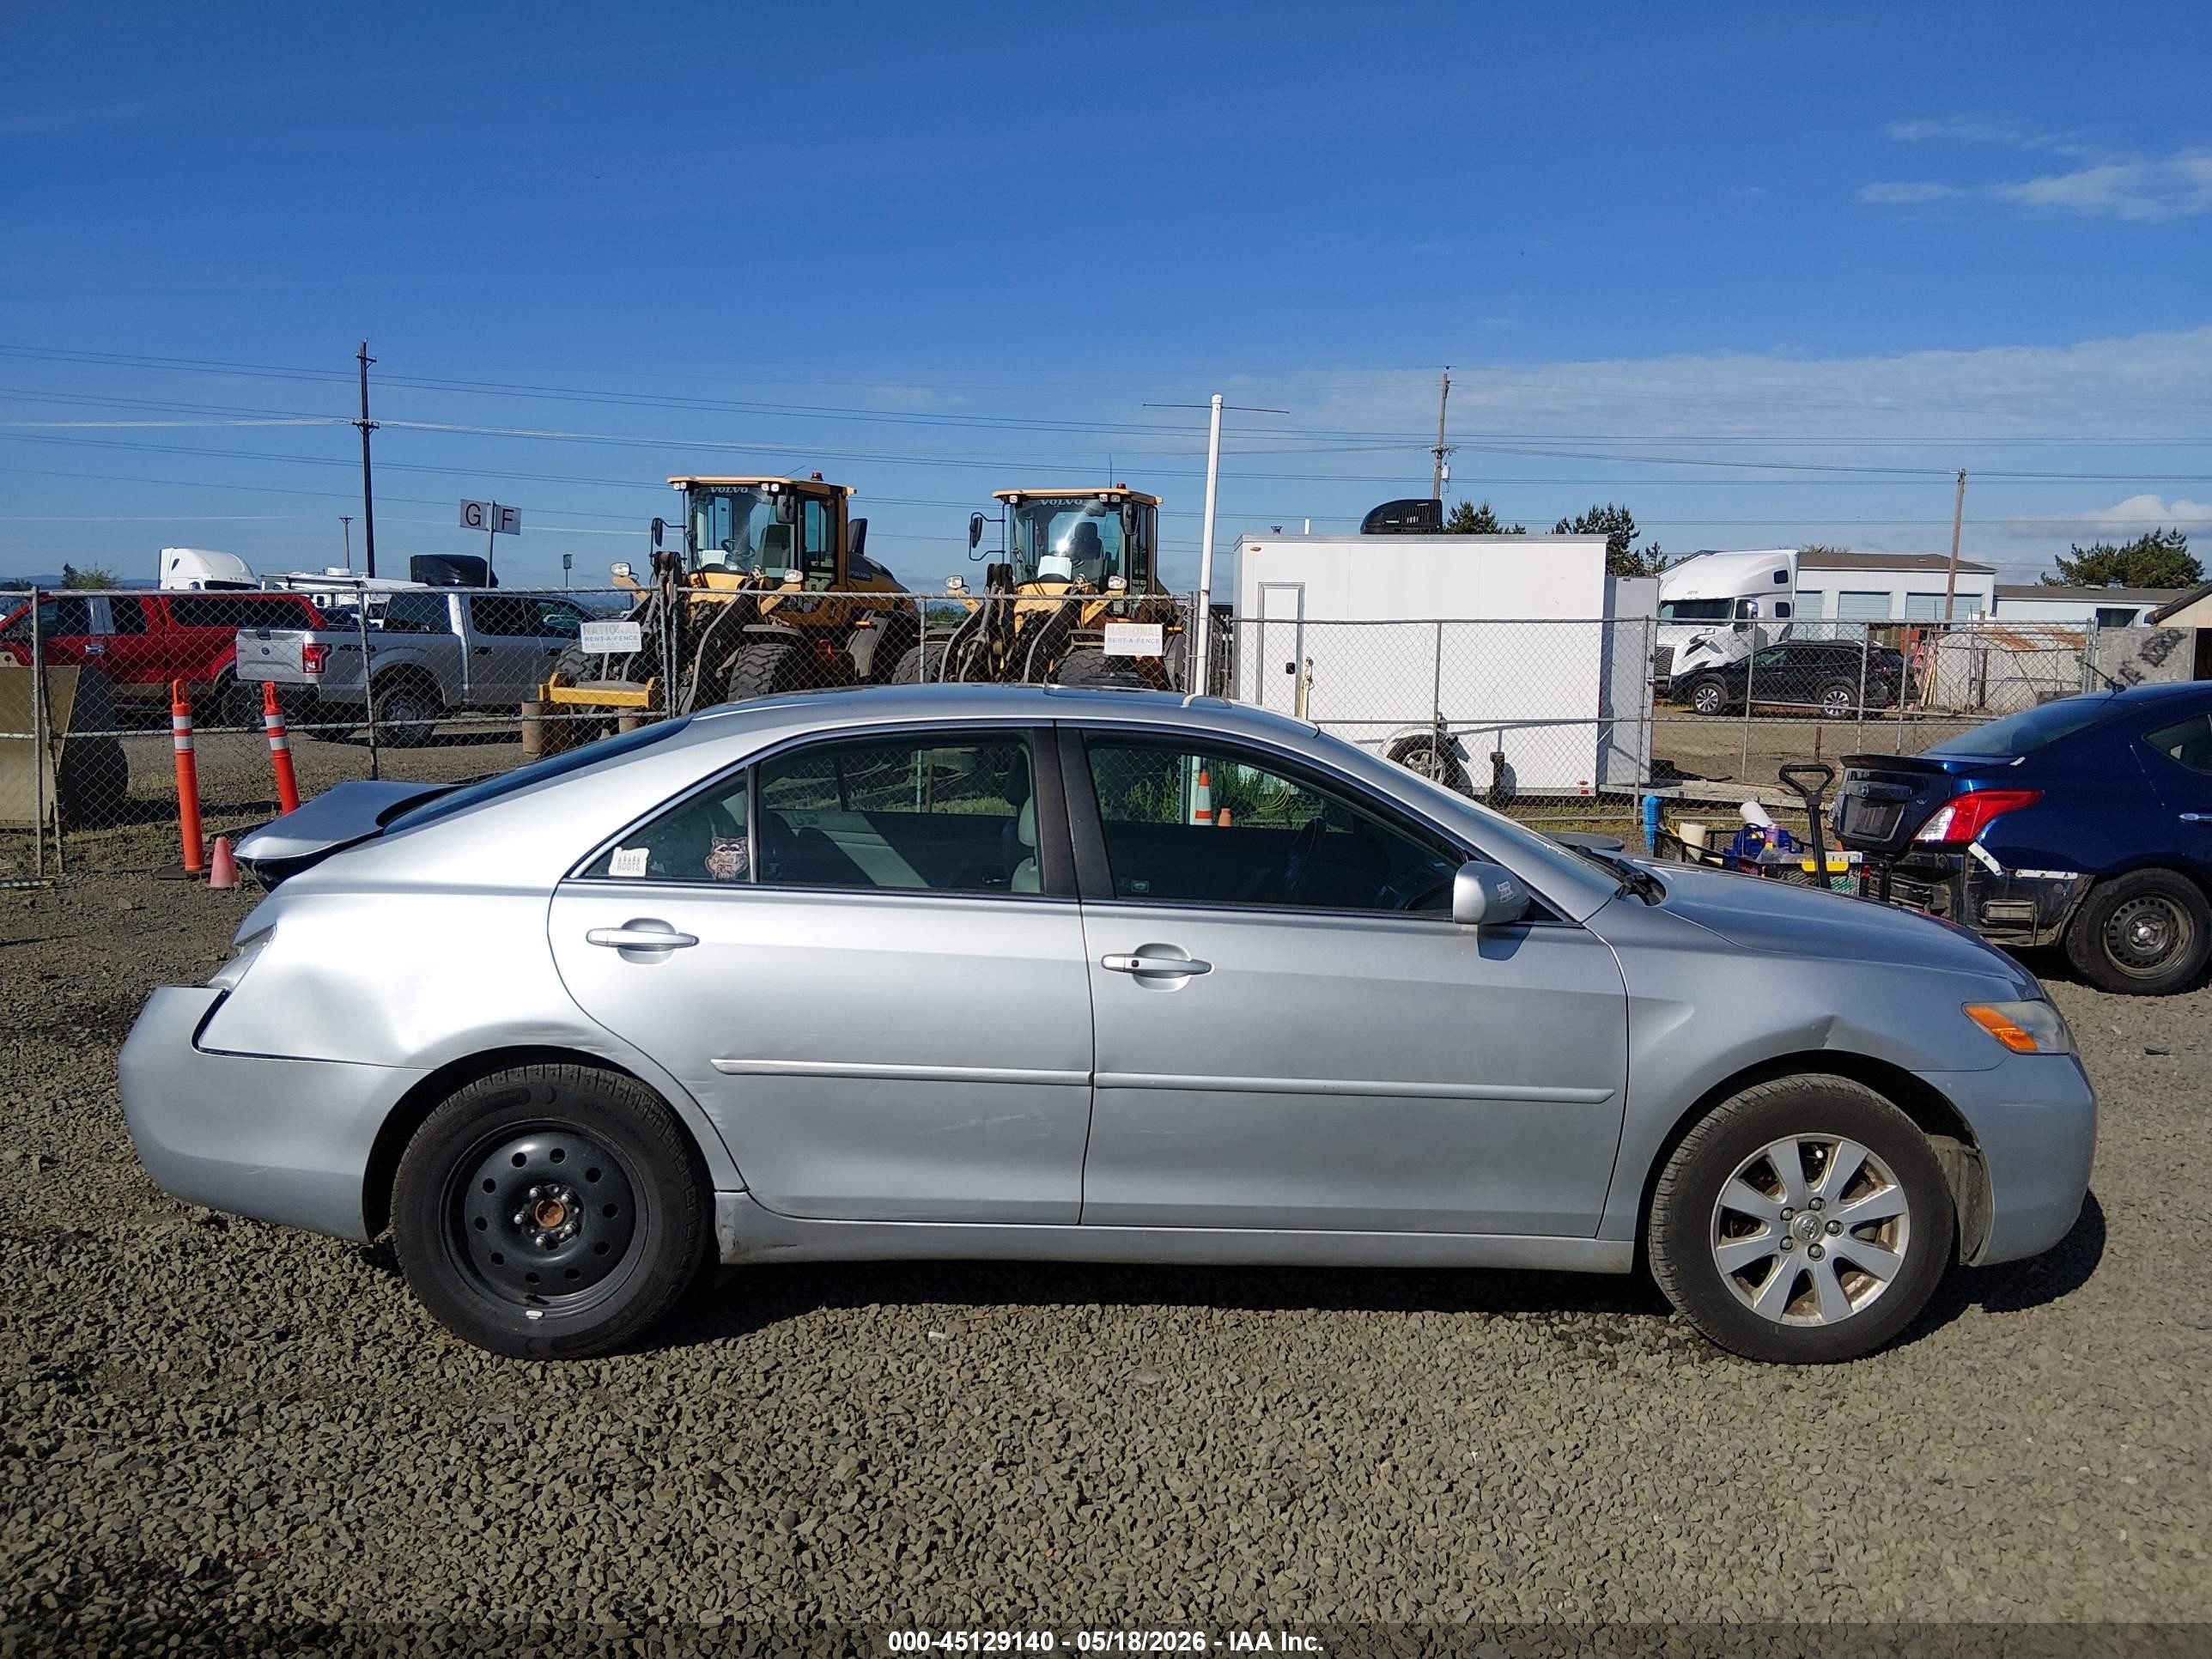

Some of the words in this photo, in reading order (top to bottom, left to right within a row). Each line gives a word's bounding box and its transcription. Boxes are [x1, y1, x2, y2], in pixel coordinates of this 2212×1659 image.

[465, 503, 482, 527] G
[501, 508, 515, 531] F
[617, 862, 641, 872] ROOTS
